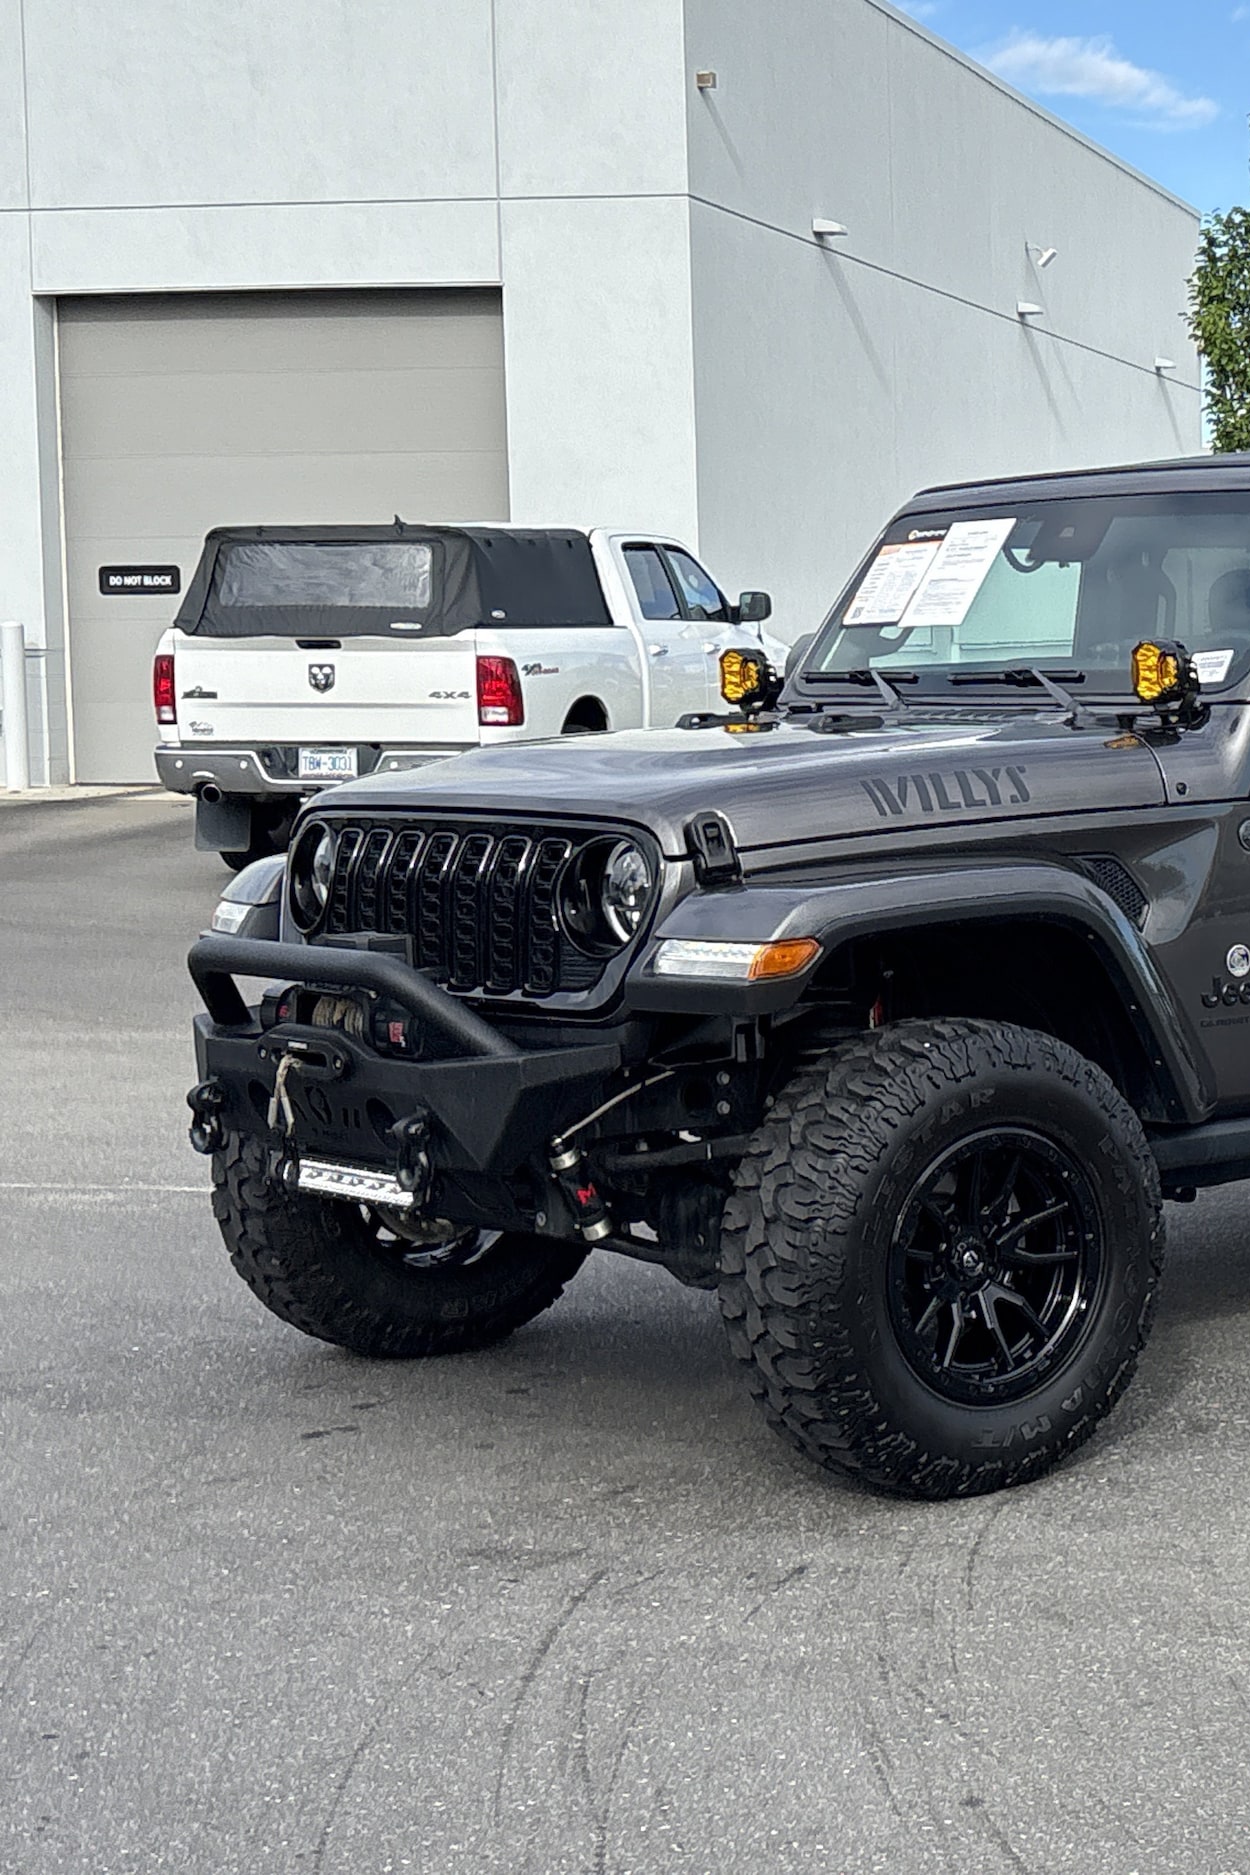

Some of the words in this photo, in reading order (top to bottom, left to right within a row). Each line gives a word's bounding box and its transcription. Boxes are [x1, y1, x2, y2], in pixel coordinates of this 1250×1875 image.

[109, 575, 123, 586] DO
[124, 575, 142, 586] NOT
[143, 574, 172, 586] BLOCK
[859, 765, 1031, 817] WILLYS
